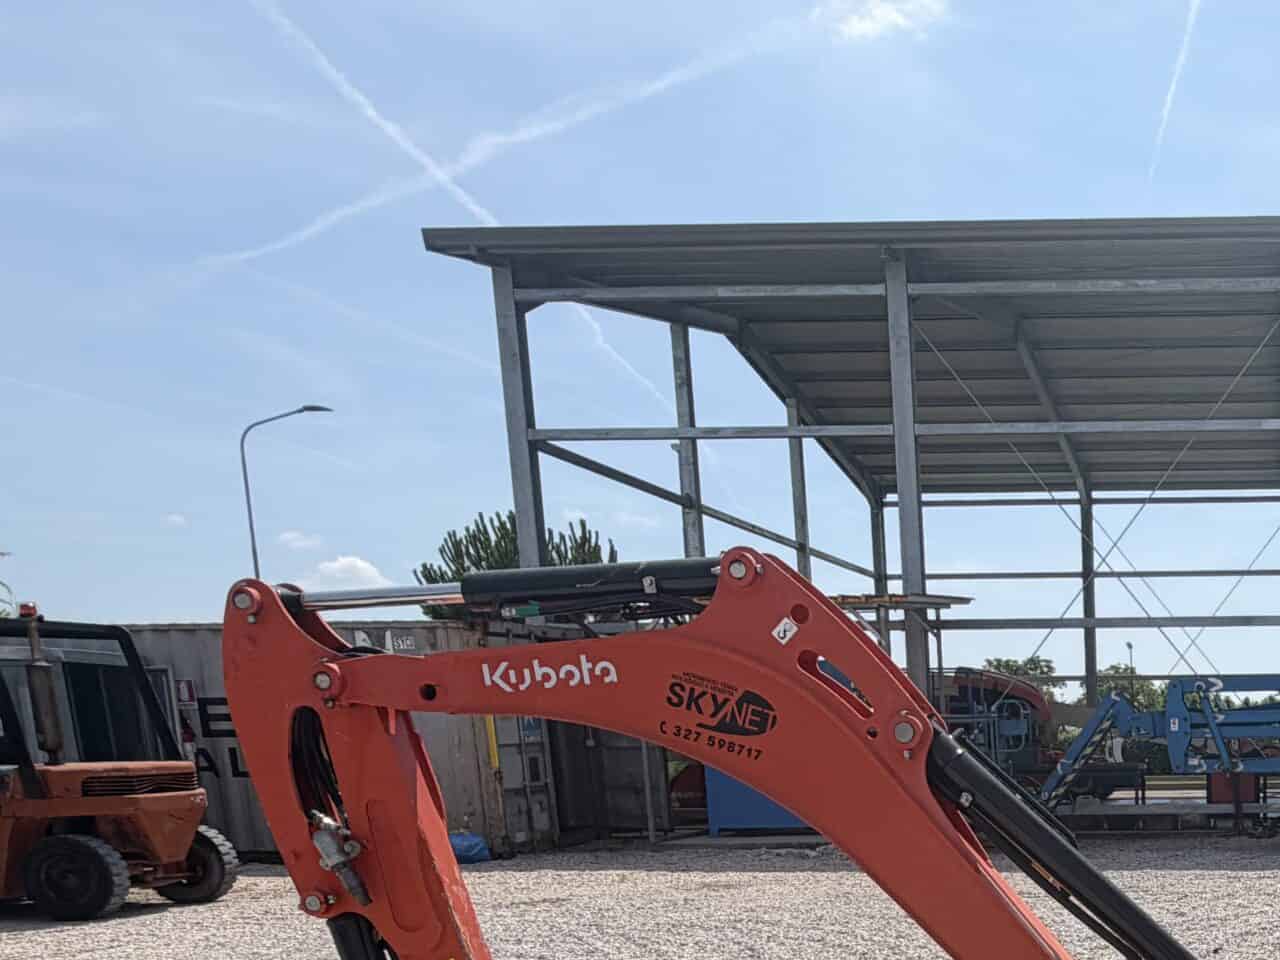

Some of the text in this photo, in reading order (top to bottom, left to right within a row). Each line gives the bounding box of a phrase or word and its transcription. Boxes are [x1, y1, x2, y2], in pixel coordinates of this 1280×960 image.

[481, 654, 618, 692] Kubota
[673, 726, 763, 760] 327 598717
